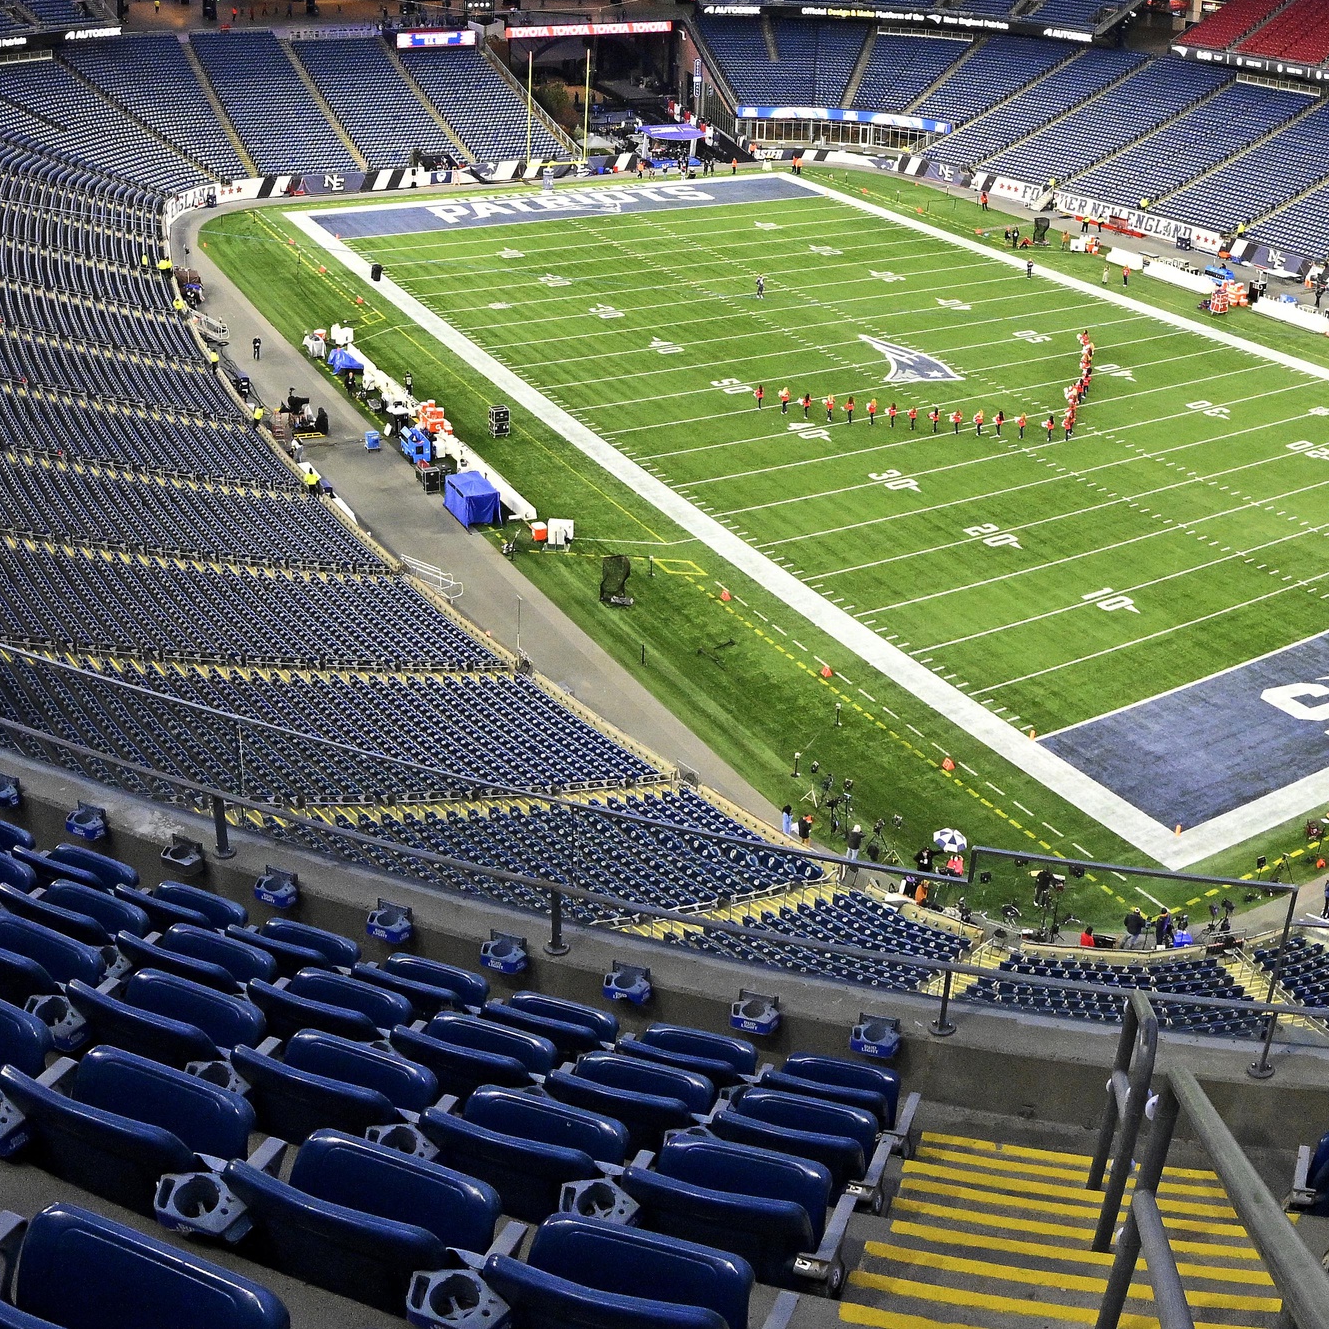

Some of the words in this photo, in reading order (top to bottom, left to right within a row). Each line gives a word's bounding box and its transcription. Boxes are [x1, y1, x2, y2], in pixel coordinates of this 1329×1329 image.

[801, 7, 827, 16] Official
[875, 10, 903, 20] Platform
[904, 12, 912, 21] of
[913, 13, 924, 22] the
[509, 26, 550, 38] TOYOTA
[553, 25, 590, 36] TOYOTA
[592, 24, 629, 35] TOYOTA
[632, 22, 669, 34] TOYOTA
[958, 18, 983, 28] England
[984, 20, 1009, 30] Patriots
[938, 163, 955, 183] NE
[323, 175, 345, 191] NE
[425, 186, 716, 225] PATRIOTS
[1090, 201, 1125, 222] NEW
[1125, 210, 1193, 241] ENGLAND
[1269, 248, 1287, 270] NE
[1012, 330, 1053, 343] 50
[1094, 364, 1134, 377] 40
[710, 377, 754, 395] 50
[1185, 400, 1231, 417] 30
[787, 422, 828, 439] 40
[868, 469, 918, 491] 30
[963, 523, 1018, 547] 20
[1081, 587, 1135, 613] 10
